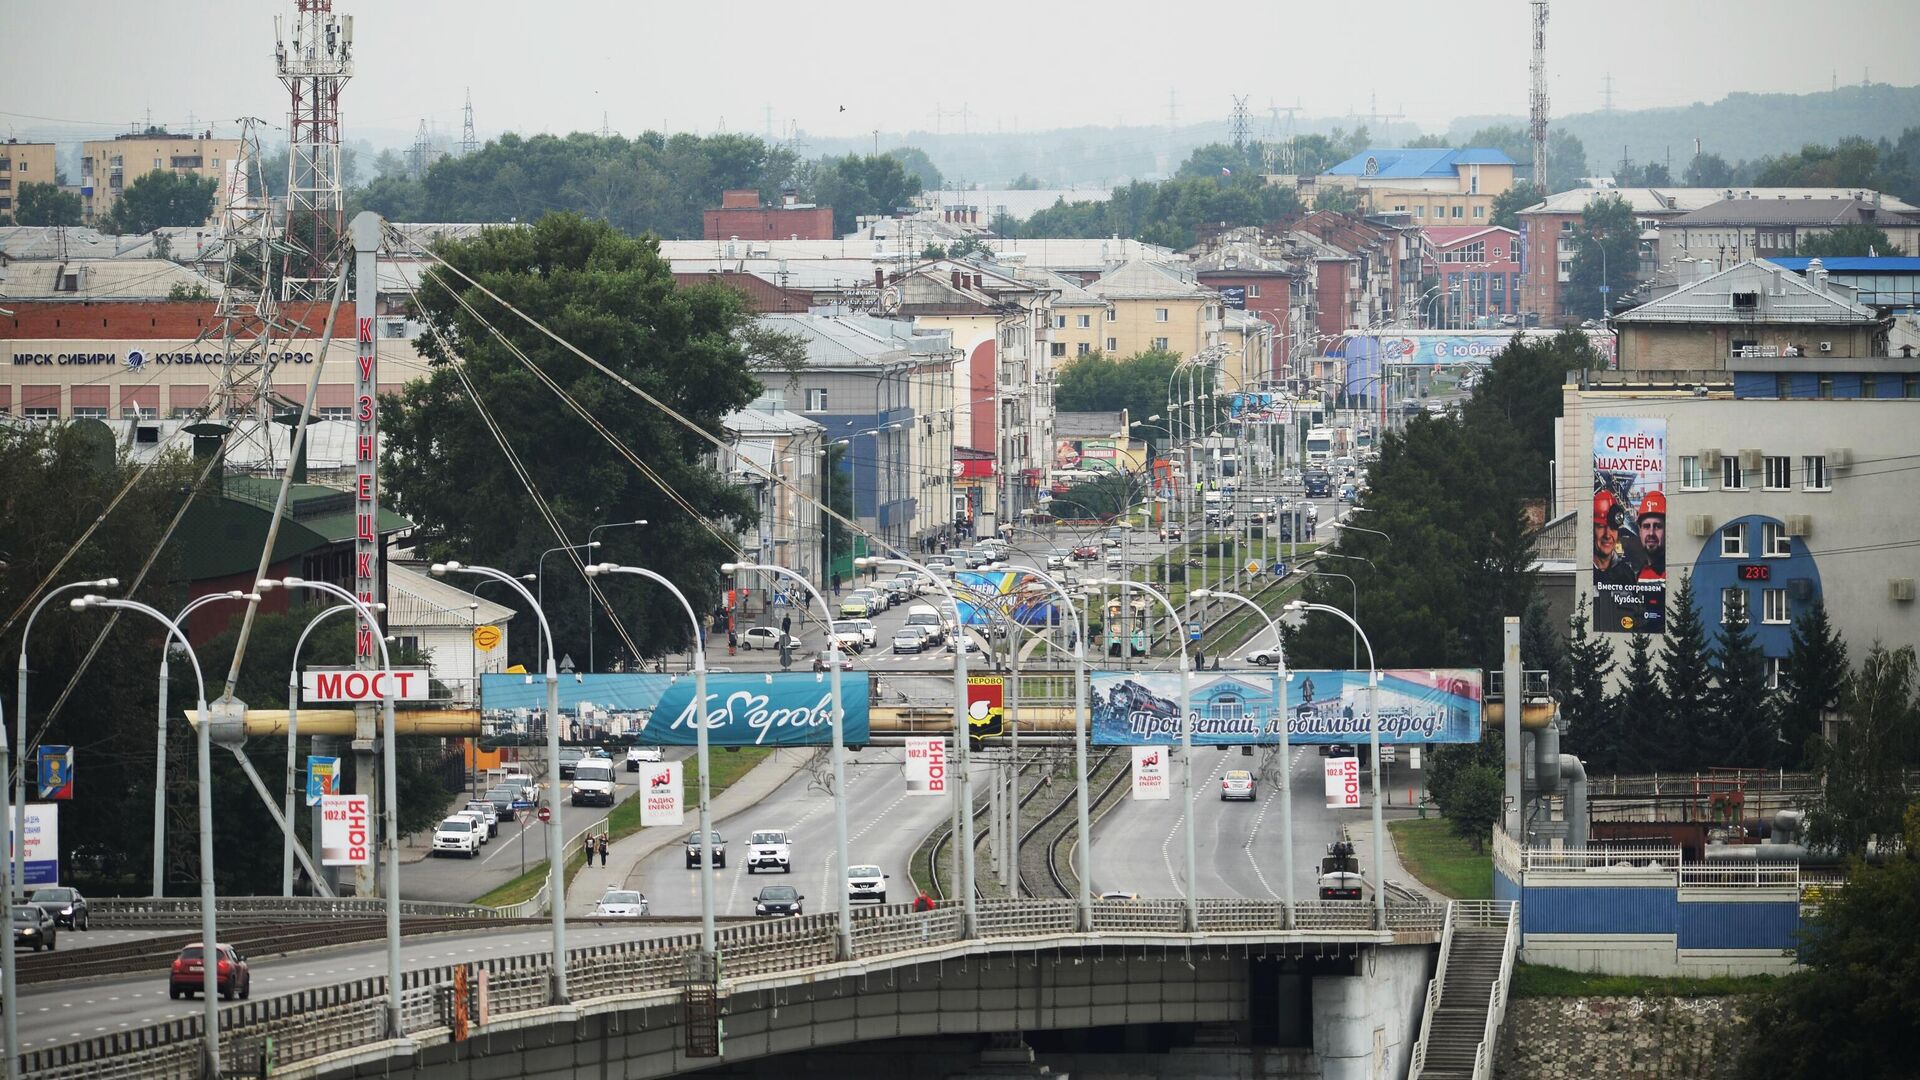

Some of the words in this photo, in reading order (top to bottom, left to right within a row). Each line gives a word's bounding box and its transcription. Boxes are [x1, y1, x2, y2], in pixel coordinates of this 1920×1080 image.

[1434, 342, 1447, 356] С
[1453, 341, 1503, 356] юбил
[14, 353, 54, 366] МРСК
[58, 353, 116, 366] СИБИРИ
[1606, 436, 1614, 449] С
[1616, 433, 1654, 452] ДНЁМ
[1598, 455, 1662, 471] ШАХТЁРА!
[357, 317, 373, 657] КУЗНЕЦКИЙ
[1597, 582, 1624, 592] Вместе
[1624, 583, 1662, 594] согреваем
[317, 673, 414, 700] МОСТ
[1130, 711, 1260, 739] Процветай,
[1264, 711, 1371, 735] любимый
[1377, 711, 1445, 738] город!
[908, 749, 928, 758] 102.8
[1326, 768, 1344, 776] 102.8
[324, 810, 347, 820] 102.8
